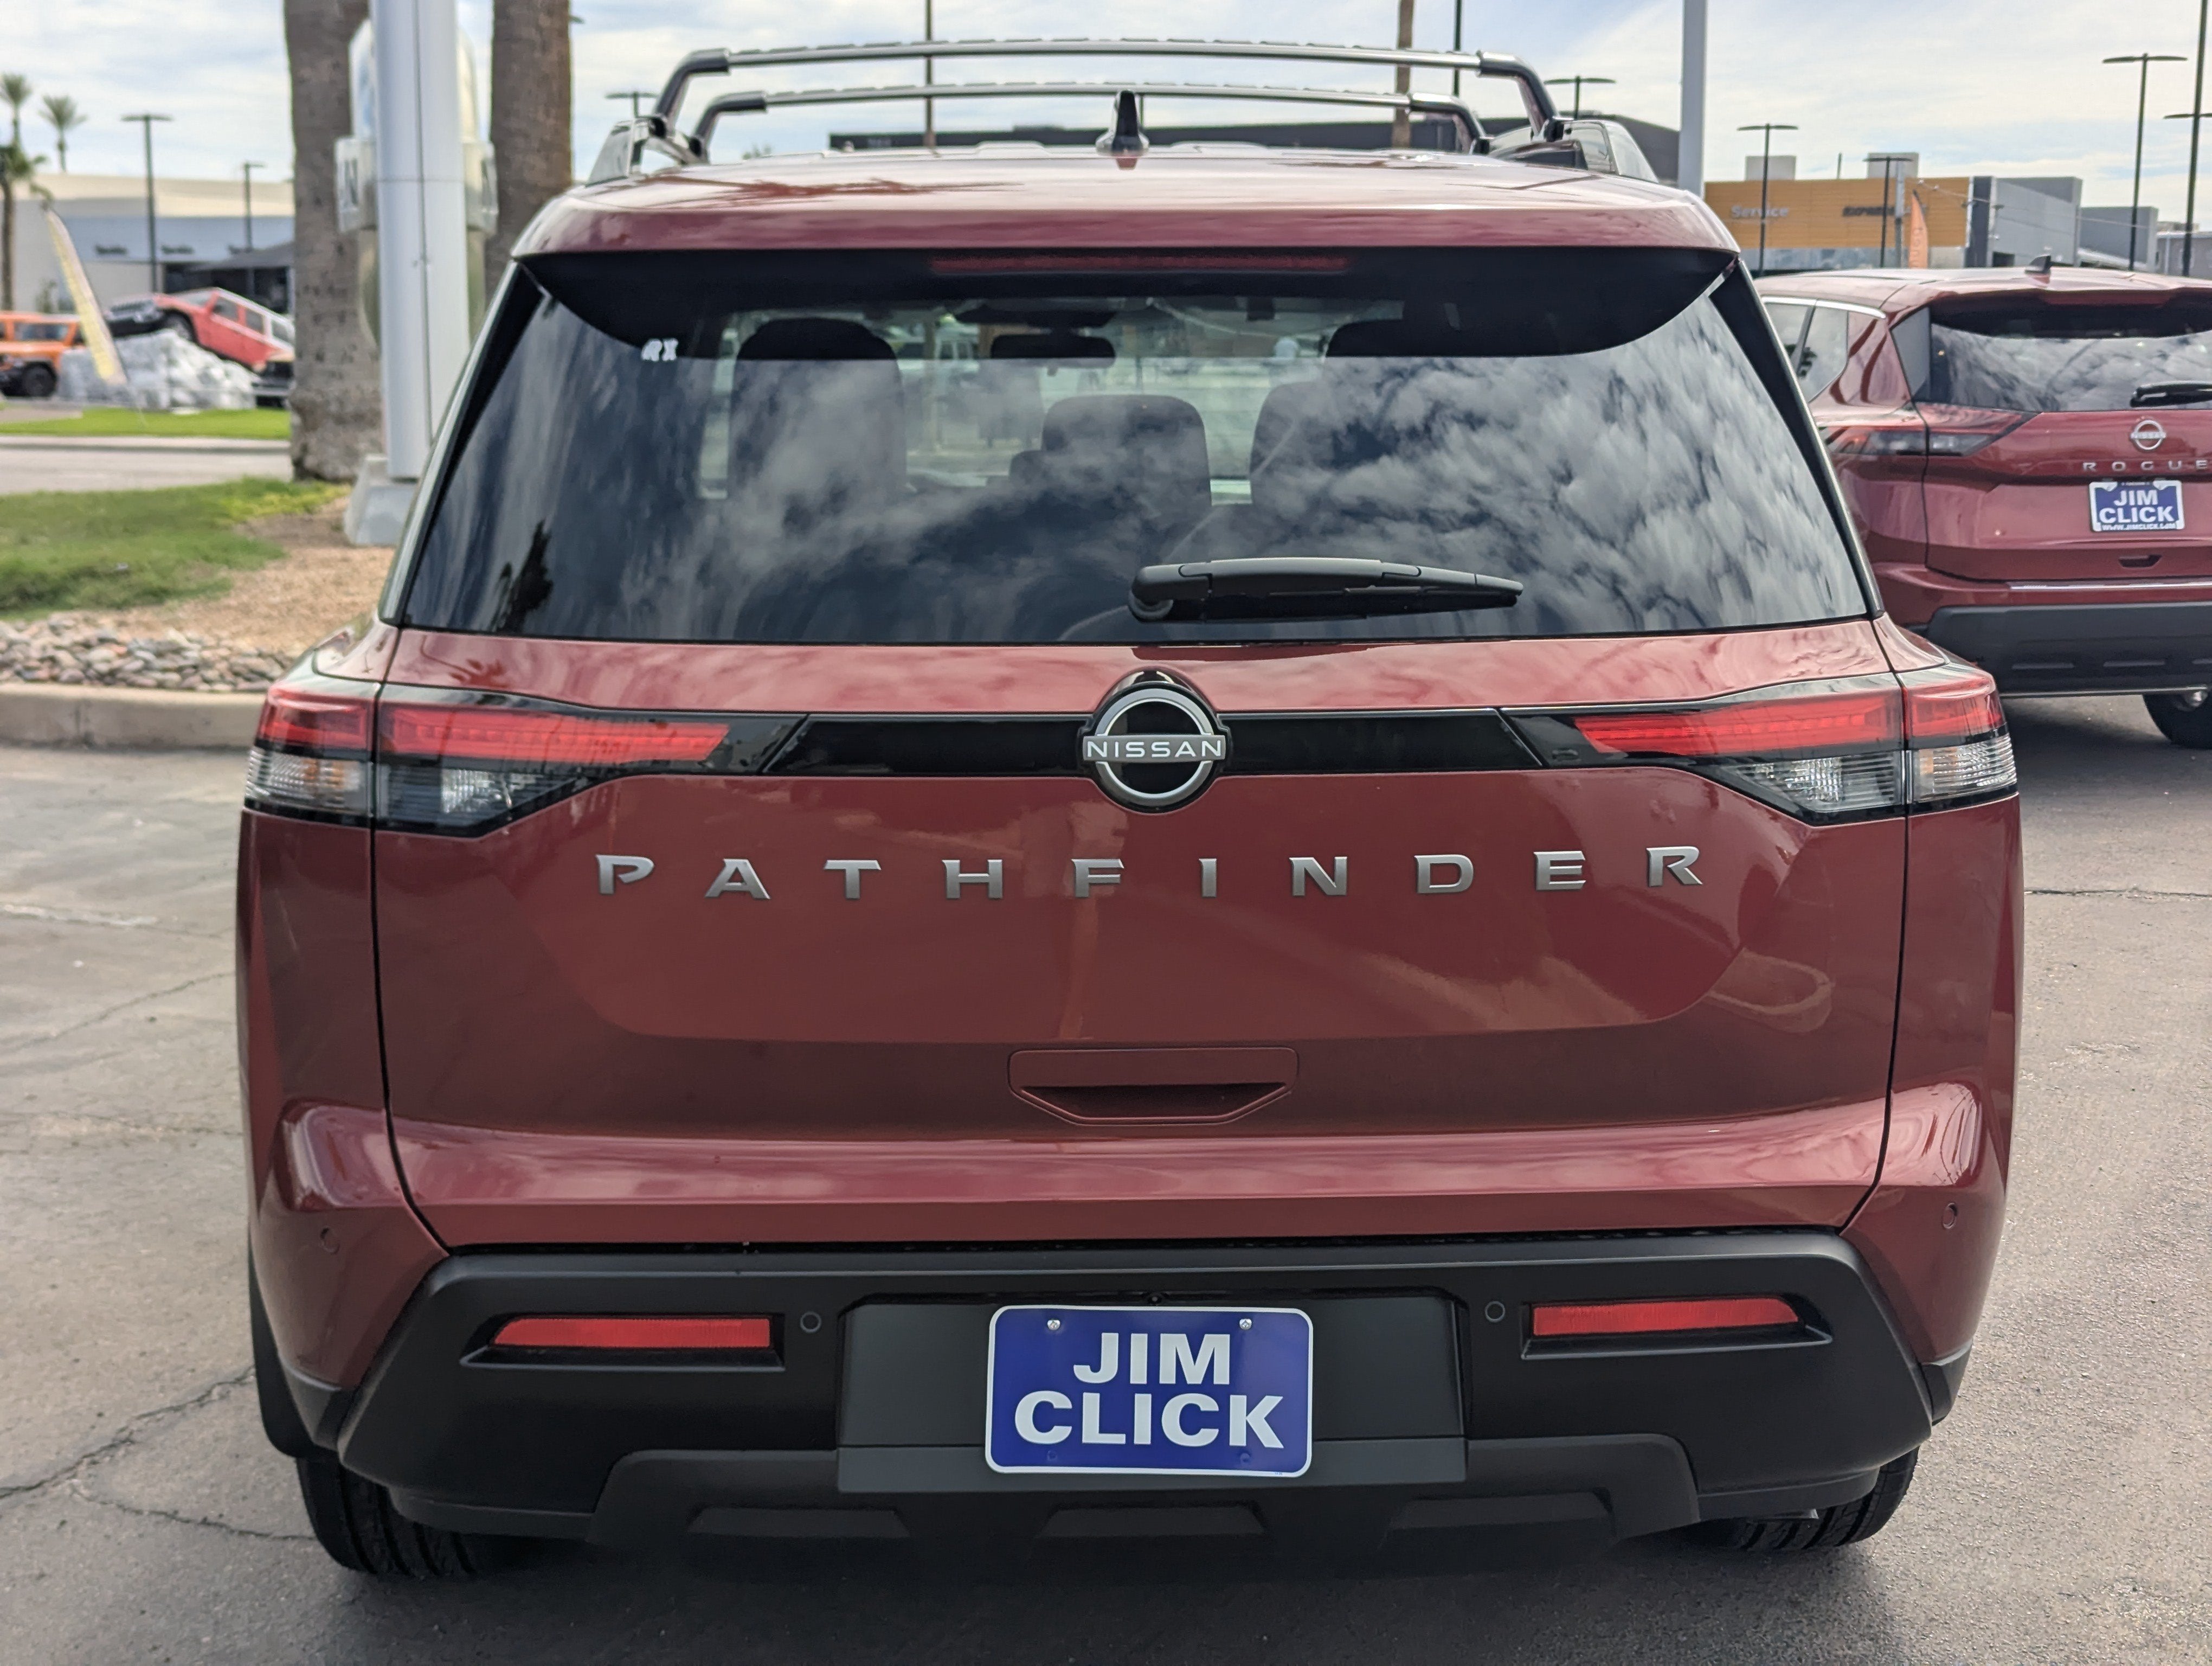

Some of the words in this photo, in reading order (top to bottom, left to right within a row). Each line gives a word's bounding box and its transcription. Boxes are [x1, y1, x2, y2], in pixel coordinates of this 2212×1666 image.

[2082, 460, 2208, 471] ROGUE
[2114, 490, 2158, 506] JIM
[2099, 507, 2175, 523] CLICK
[1087, 740, 1221, 758] NISSAN
[595, 845, 1703, 899] PATHFINDER
[1073, 1332, 1231, 1385] JIM
[1014, 1390, 1284, 1449] CLICK
